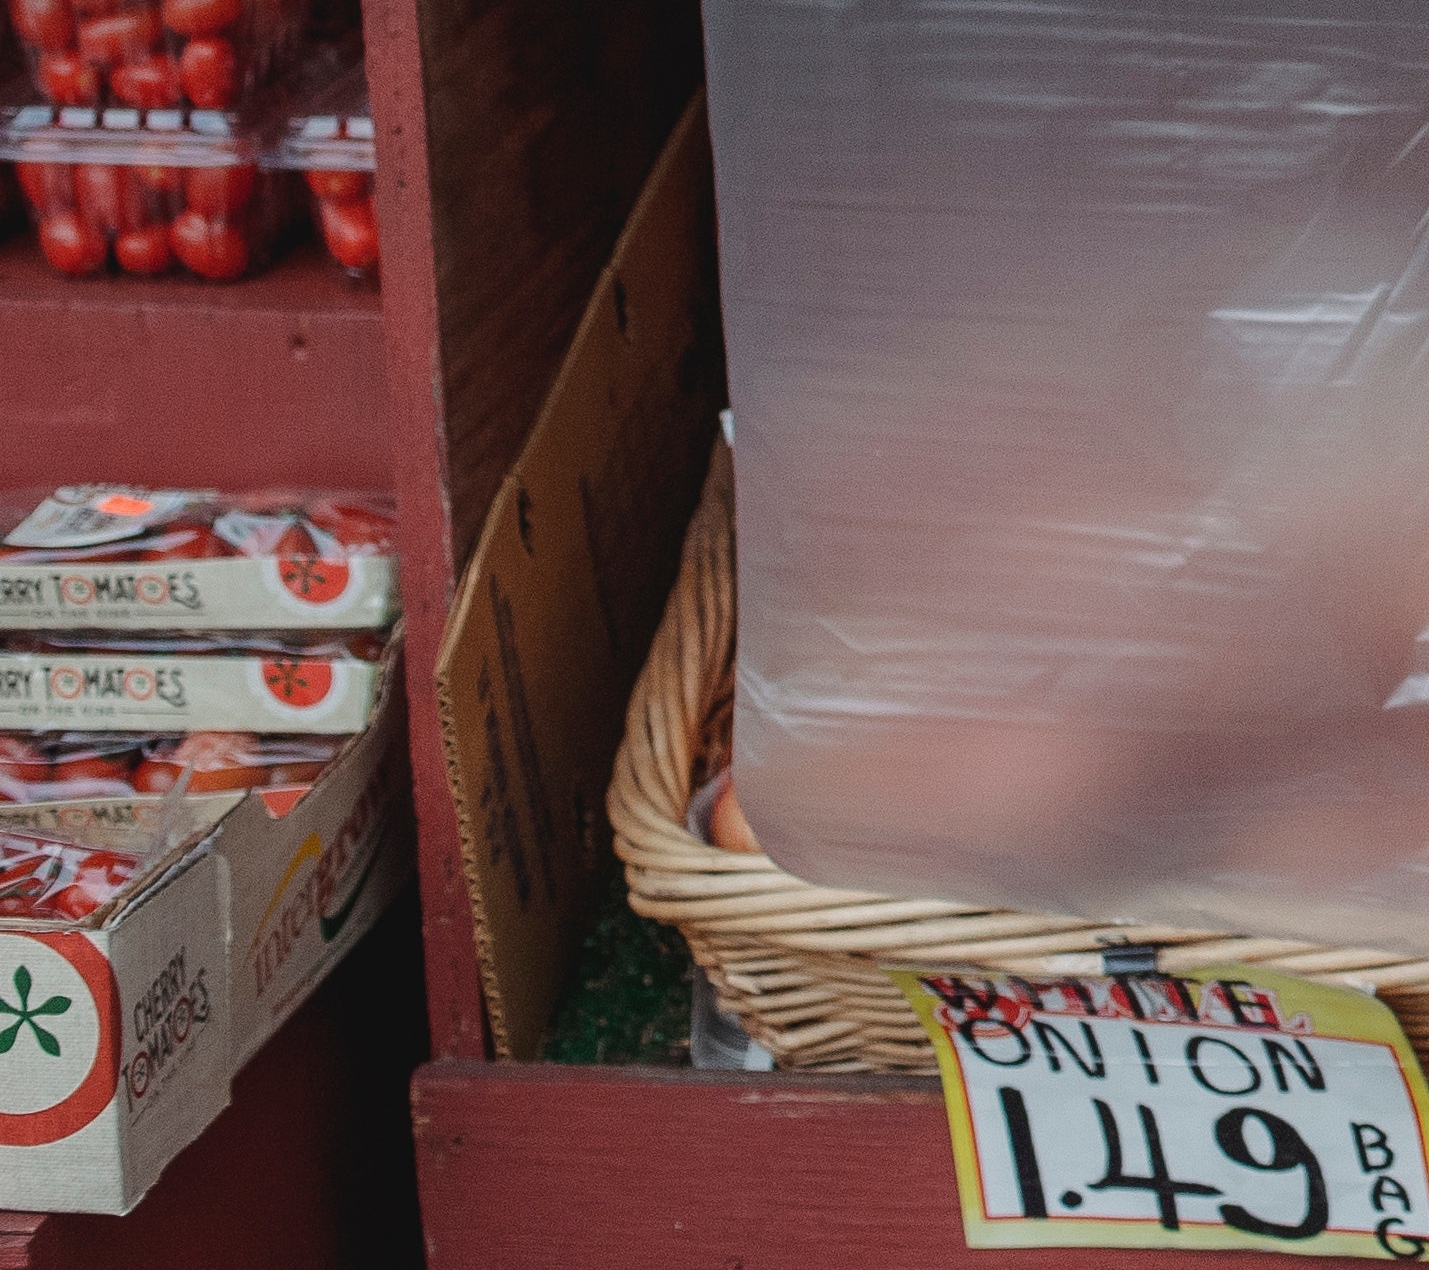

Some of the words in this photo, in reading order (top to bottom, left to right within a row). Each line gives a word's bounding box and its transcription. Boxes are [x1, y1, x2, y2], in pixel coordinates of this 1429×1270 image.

[51, 569, 204, 610] TOMATOES
[41, 665, 192, 709] TOMATOES
[121, 966, 213, 1115] TOMATOES
[133, 944, 188, 1044] CHERRY
[960, 1016, 1328, 1095] ONION
[996, 1085, 1331, 1240] 1.49
[1350, 1120, 1429, 1261] BAG
